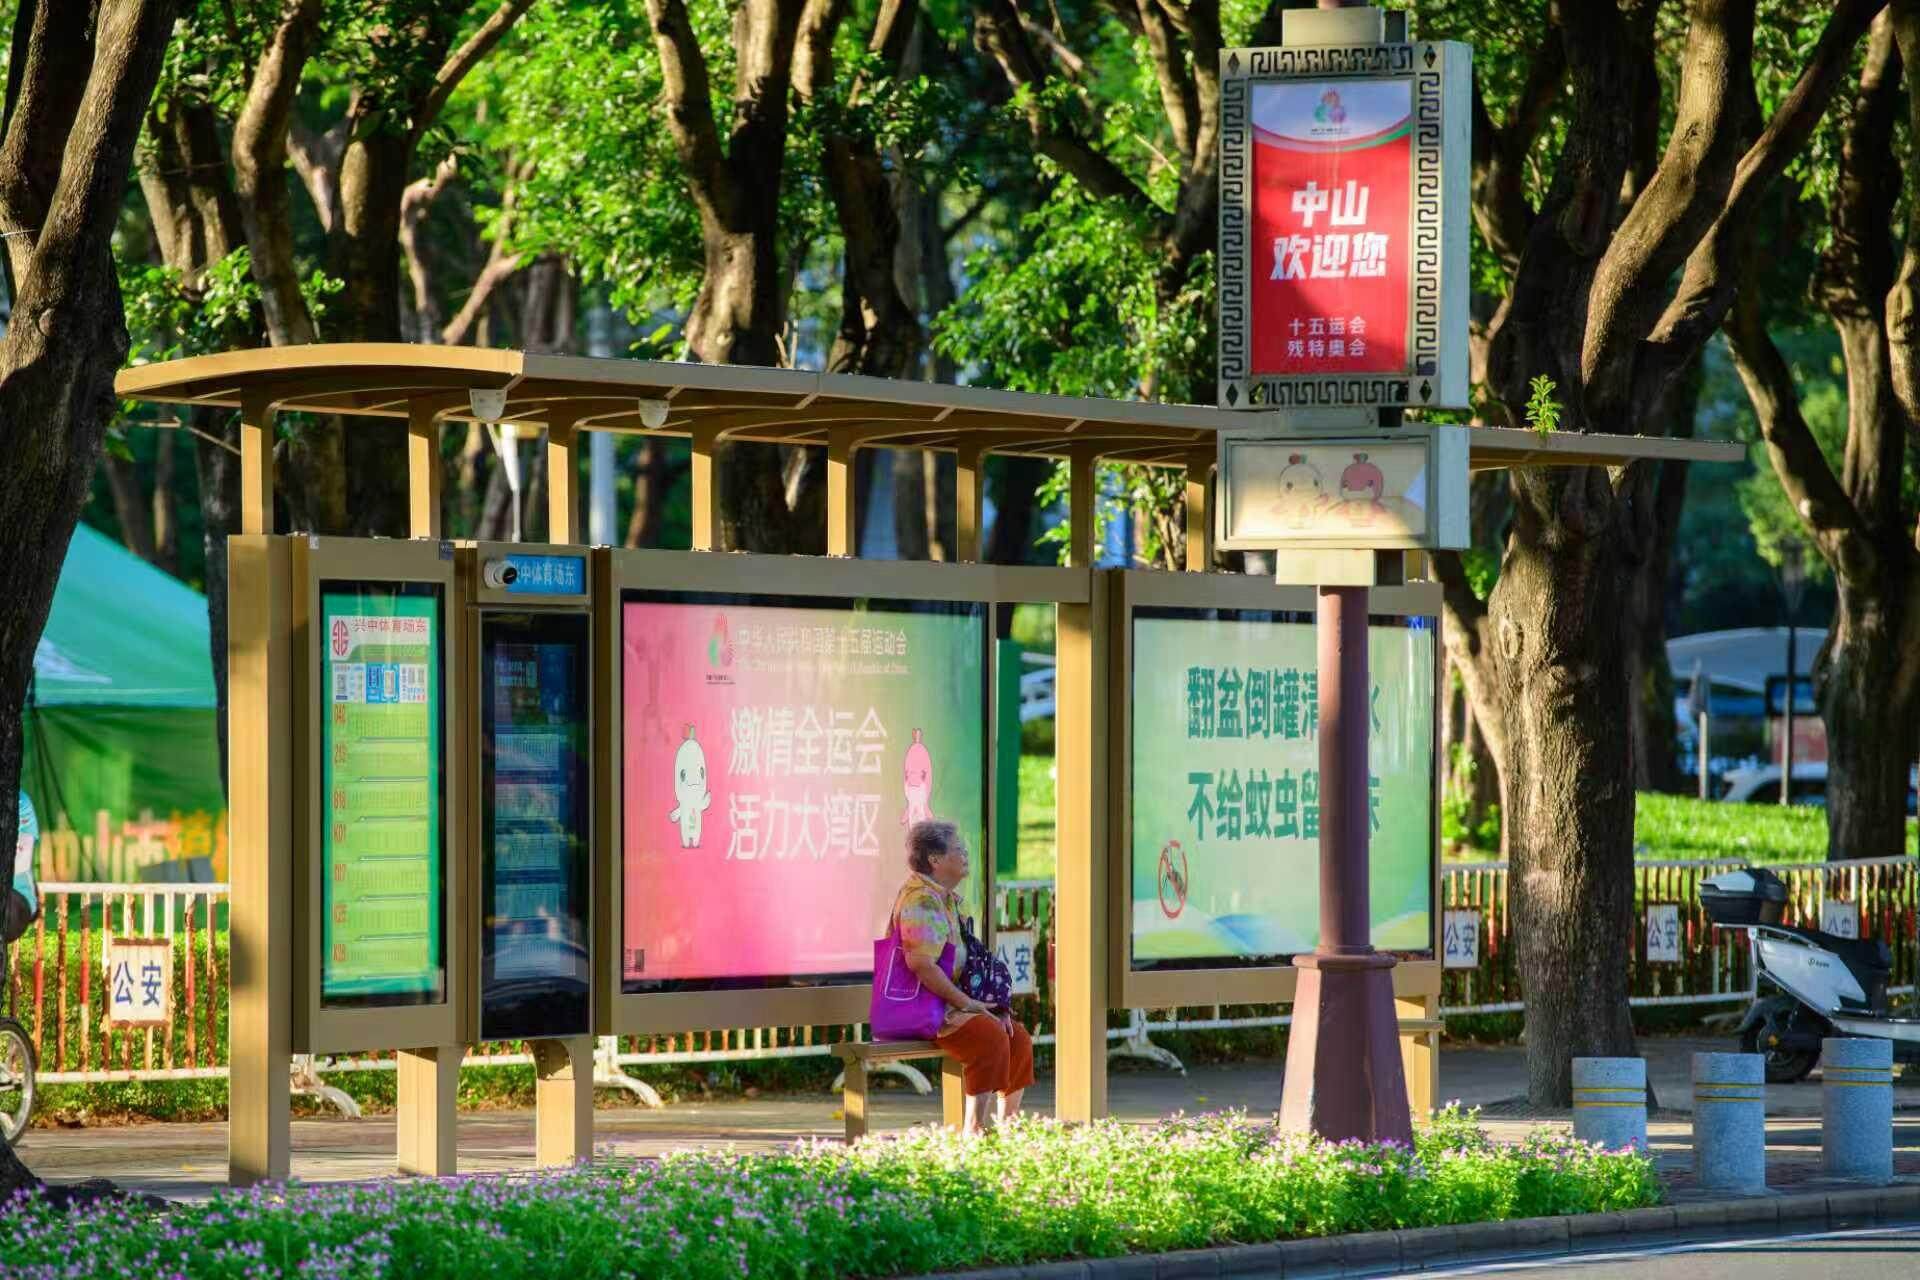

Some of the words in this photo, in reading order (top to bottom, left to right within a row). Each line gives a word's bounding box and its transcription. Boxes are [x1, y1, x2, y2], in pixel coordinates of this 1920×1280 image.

[1291, 180, 1369, 228] 中山
[1269, 232, 1390, 281] 欢迎您
[1287, 338, 1366, 358] 残特奥会
[1288, 316, 1367, 335] 十五运会
[1187, 666, 1381, 741] 翻盆倒罐清
[728, 705, 888, 777] 激情全运会
[726, 791, 883, 861] 活力大湾区
[1187, 768, 1381, 841] 不给蚊虫留
[1446, 922, 1475, 957] 公安
[1648, 914, 1676, 950] 公安
[113, 960, 162, 1007] 公安
